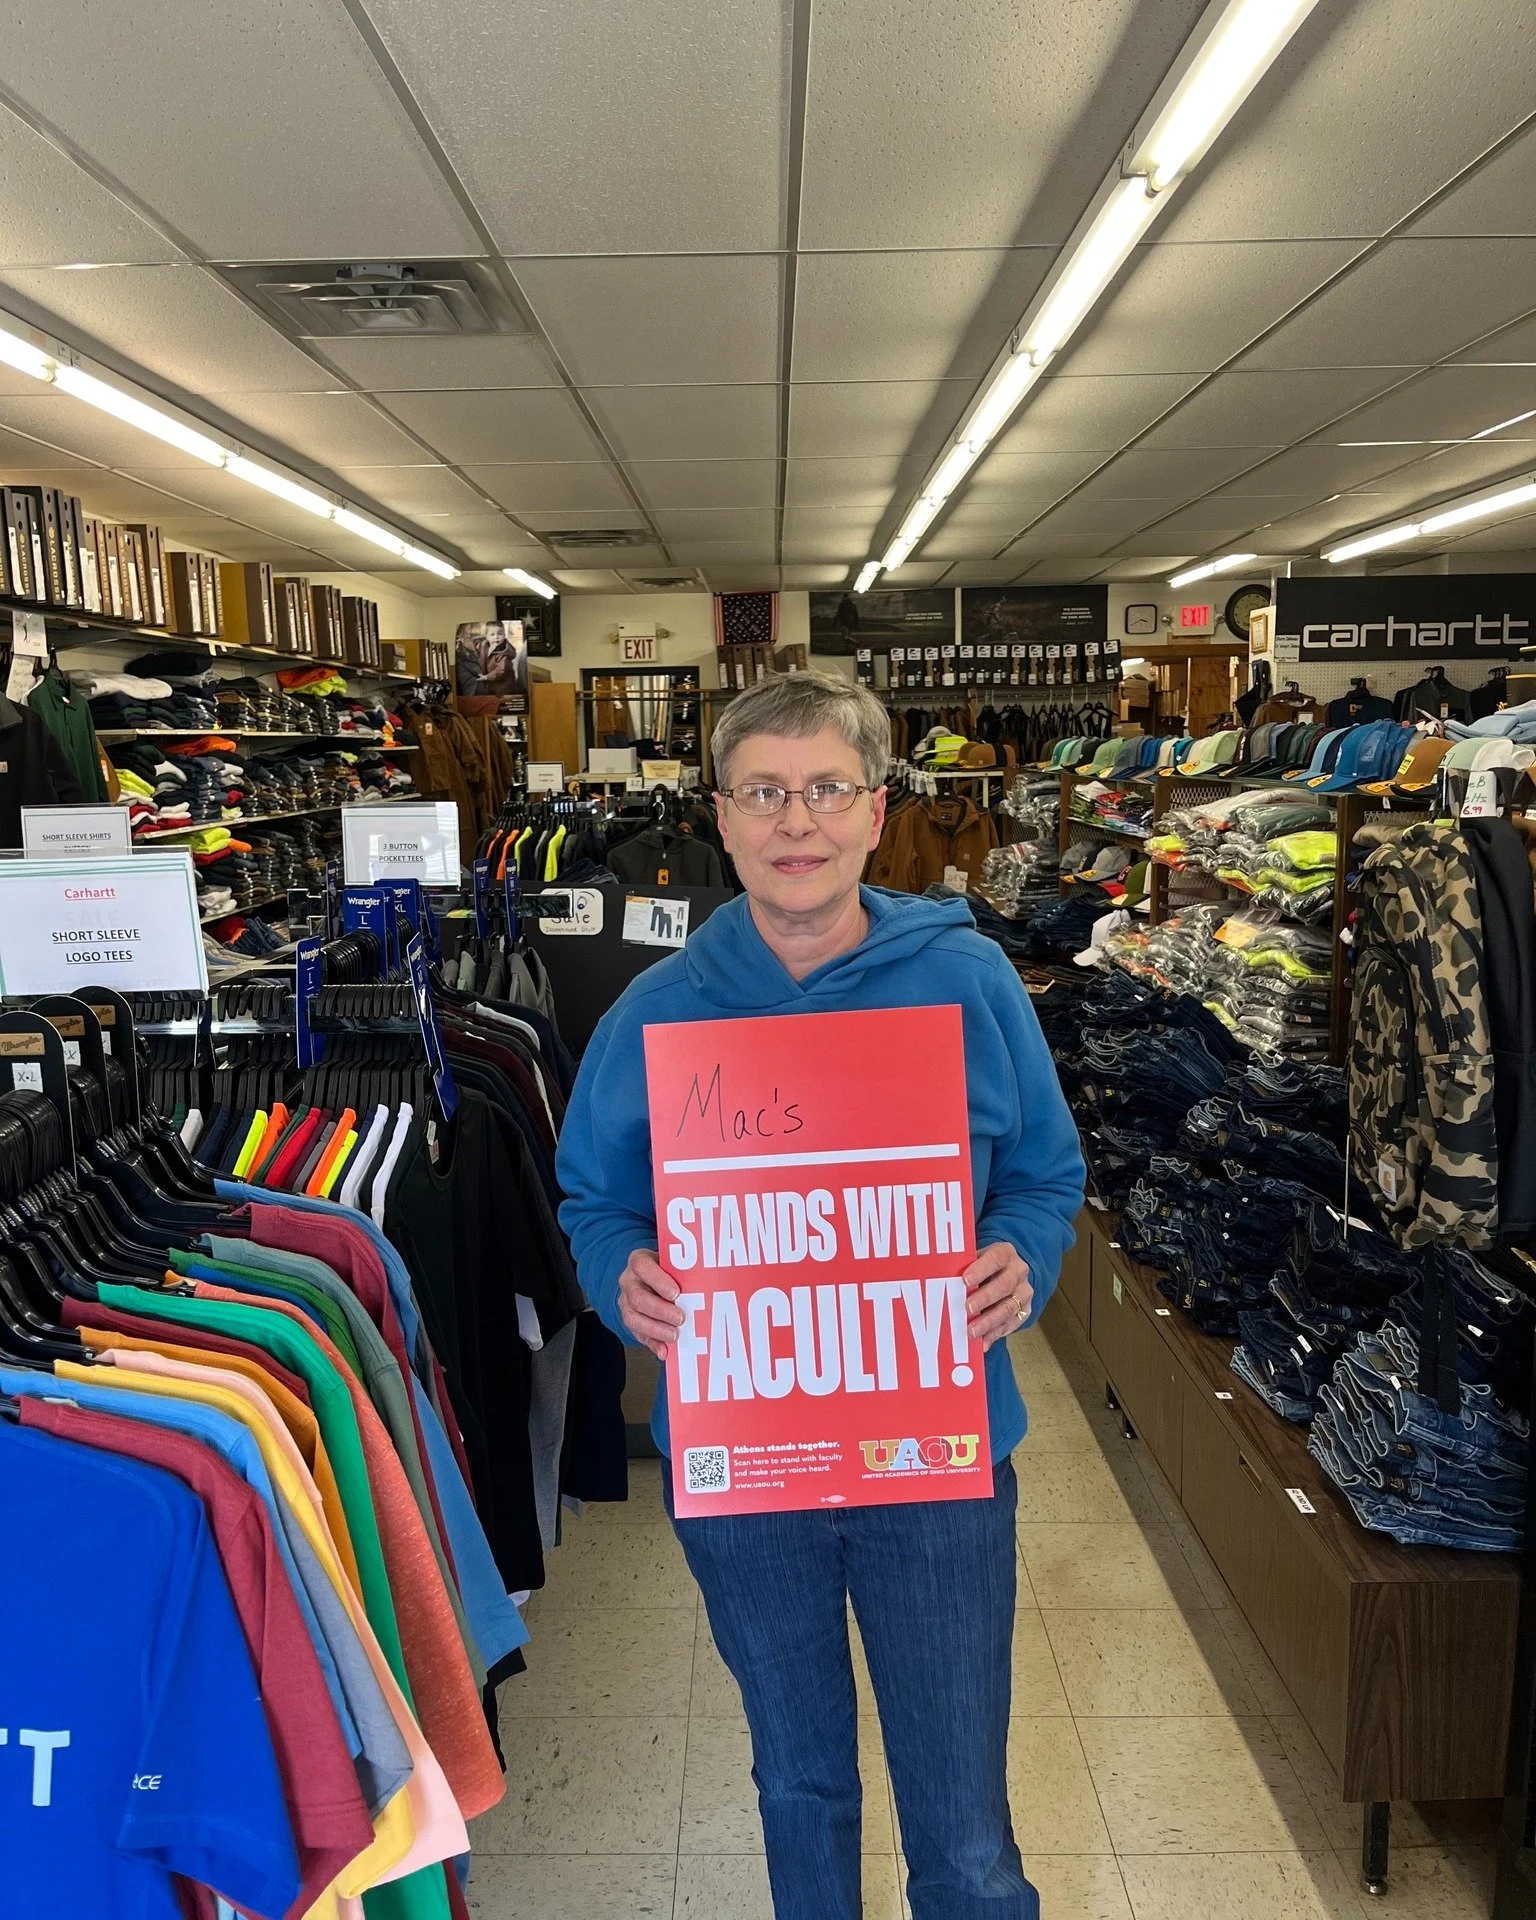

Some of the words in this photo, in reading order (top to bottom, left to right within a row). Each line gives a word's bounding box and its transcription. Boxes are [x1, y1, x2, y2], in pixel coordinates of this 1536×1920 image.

[1181, 606, 1209, 627] EXIT
[1303, 614, 1529, 648] carhartt
[624, 639, 653, 659] EXIT
[42, 833, 64, 841] SHORT
[64, 887, 116, 899] Carhartt
[394, 888, 411, 897] ngler
[347, 897, 381, 908] Wrangler
[361, 916, 368, 924] L
[52, 930, 94, 942] SHORT
[97, 928, 140, 940] SLEEVE
[66, 951, 100, 963] LOGO
[104, 950, 132, 961] TEES
[56, 1018, 82, 1030] angler
[1, 1036, 42, 1052] Wrangler
[676, 1064, 803, 1142] Mac's
[667, 1189, 837, 1270] STANDS
[843, 1181, 965, 1260] WITH
[676, 1277, 974, 1403] FACULTY!
[733, 1445, 765, 1455] Athens
[766, 1442, 797, 1452] stands
[798, 1440, 840, 1452] together.
[859, 1434, 980, 1471] UAOU
[733, 1458, 751, 1467] Scan
[752, 1456, 769, 1465] here
[771, 1456, 779, 1464] to
[780, 1454, 800, 1464] stand
[801, 1453, 817, 1462] with
[818, 1453, 843, 1463] faculty
[734, 1469, 748, 1477] and
[749, 1467, 768, 1477] make
[770, 1467, 787, 1477] your
[788, 1465, 807, 1474] voice
[808, 1464, 832, 1473] heard.
[945, 1467, 982, 1475] UNIVERSITY
[735, 1479, 785, 1489] www.uaou.org
